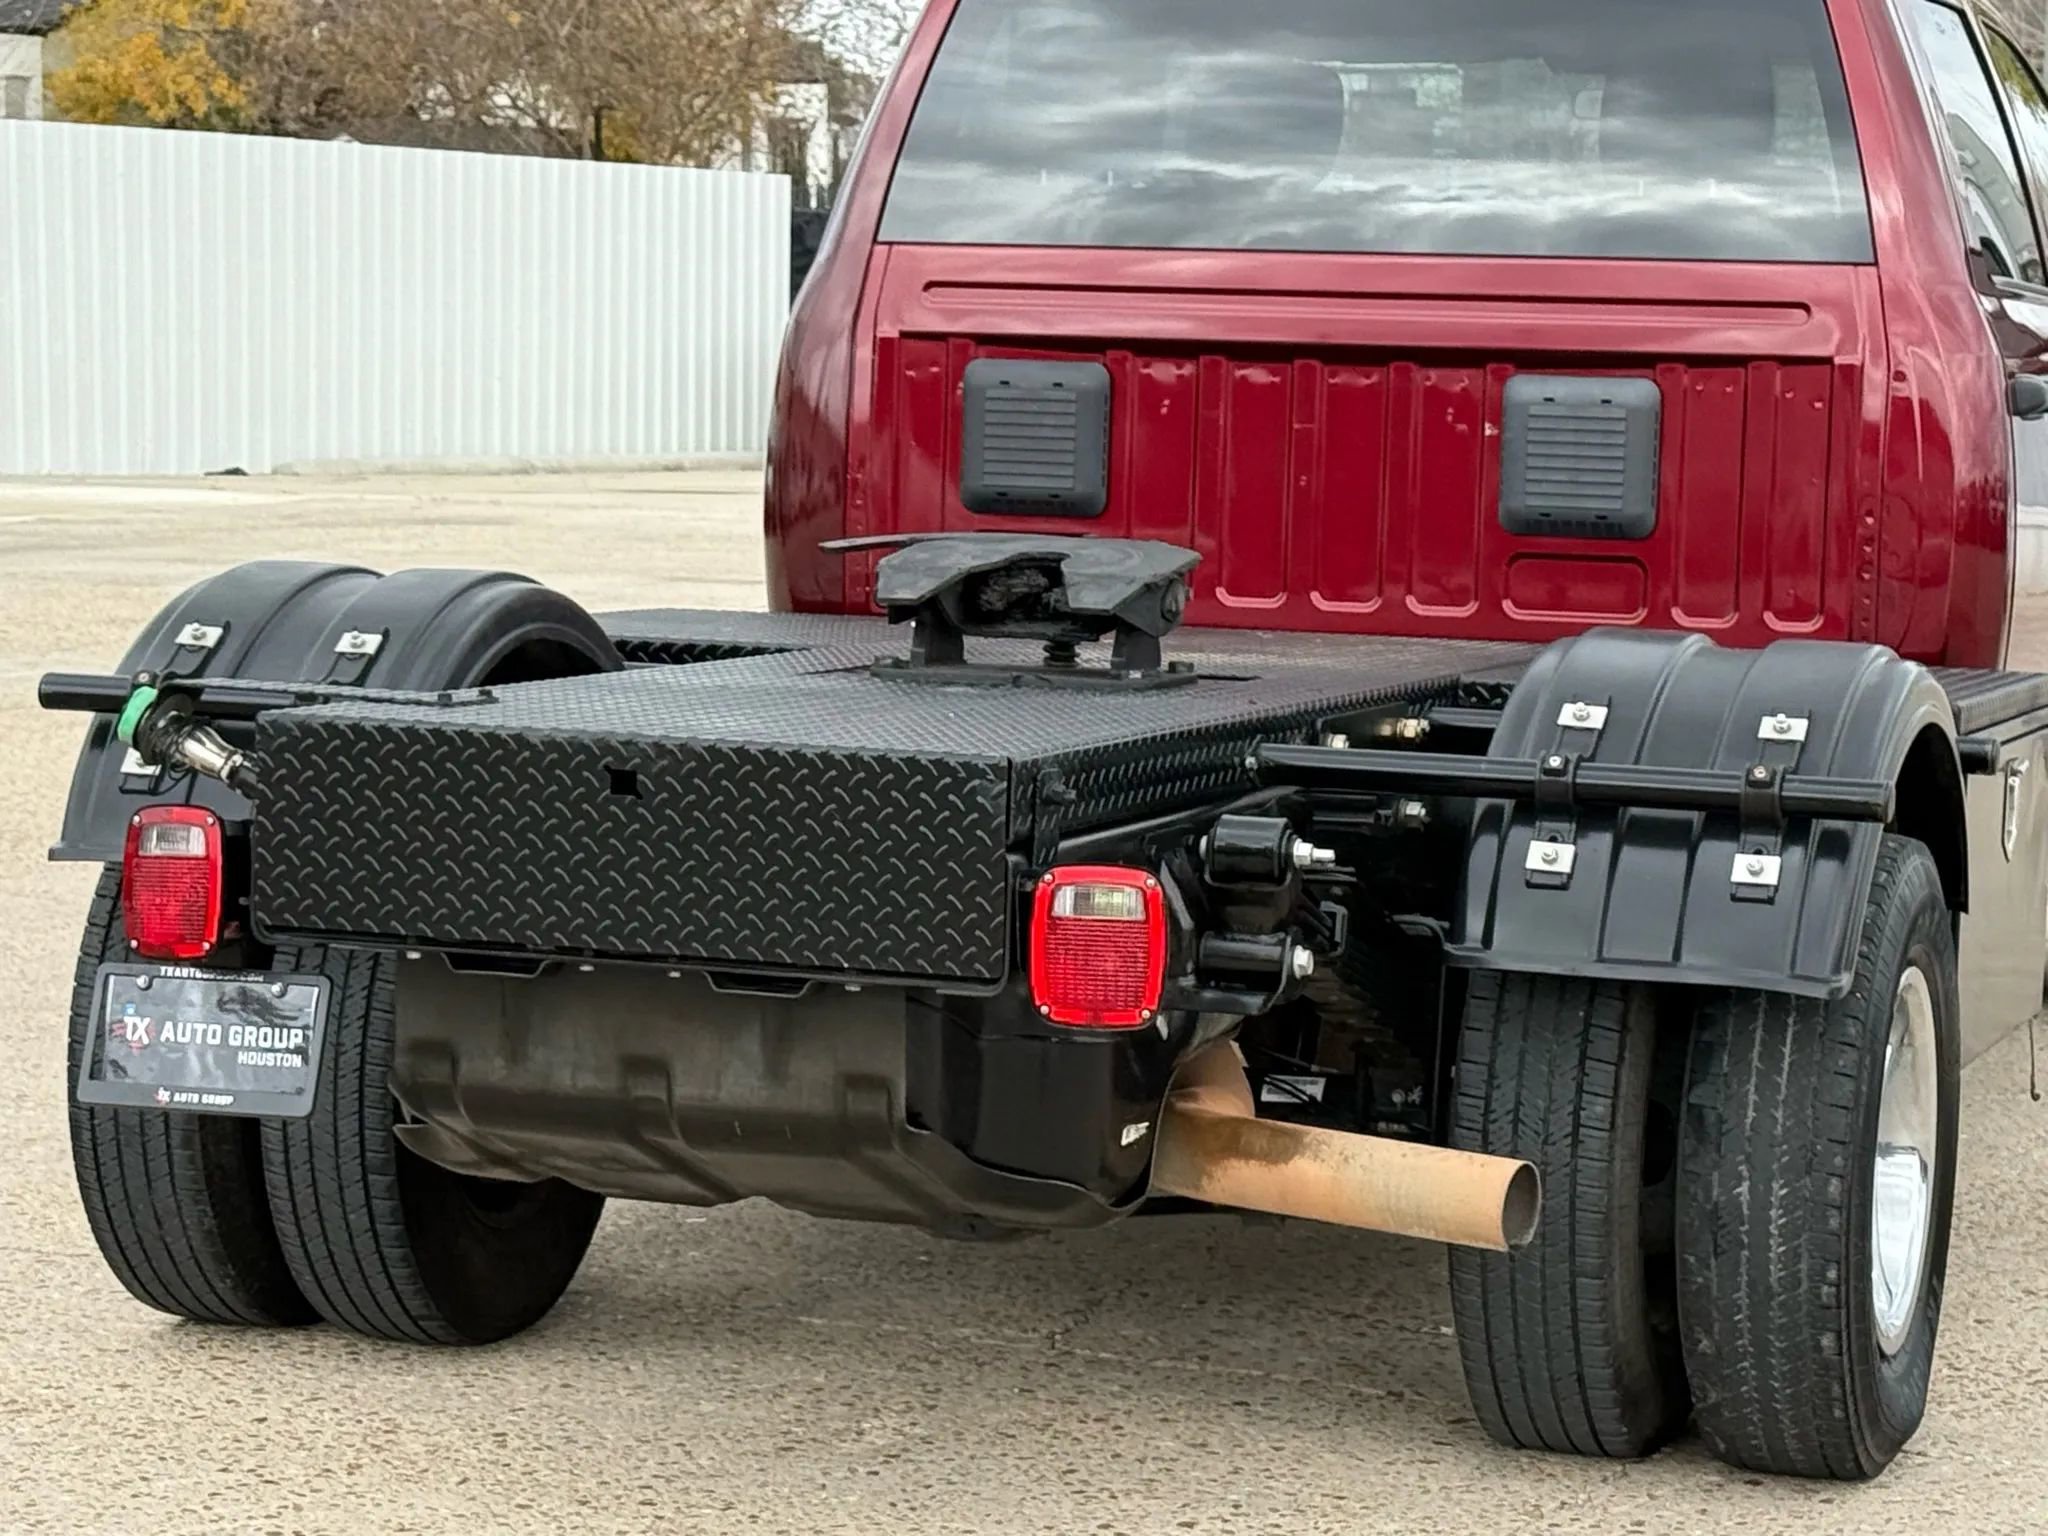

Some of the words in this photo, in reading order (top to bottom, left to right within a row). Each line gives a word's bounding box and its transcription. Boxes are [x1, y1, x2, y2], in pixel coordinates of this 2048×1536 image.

[123, 1016, 151, 1045] TX
[160, 1020, 222, 1046] AUTO
[228, 1025, 304, 1050] GROUP
[237, 1051, 302, 1068] HOUSTON
[173, 1091, 200, 1104] AUTO
[201, 1093, 234, 1106] GROUP
